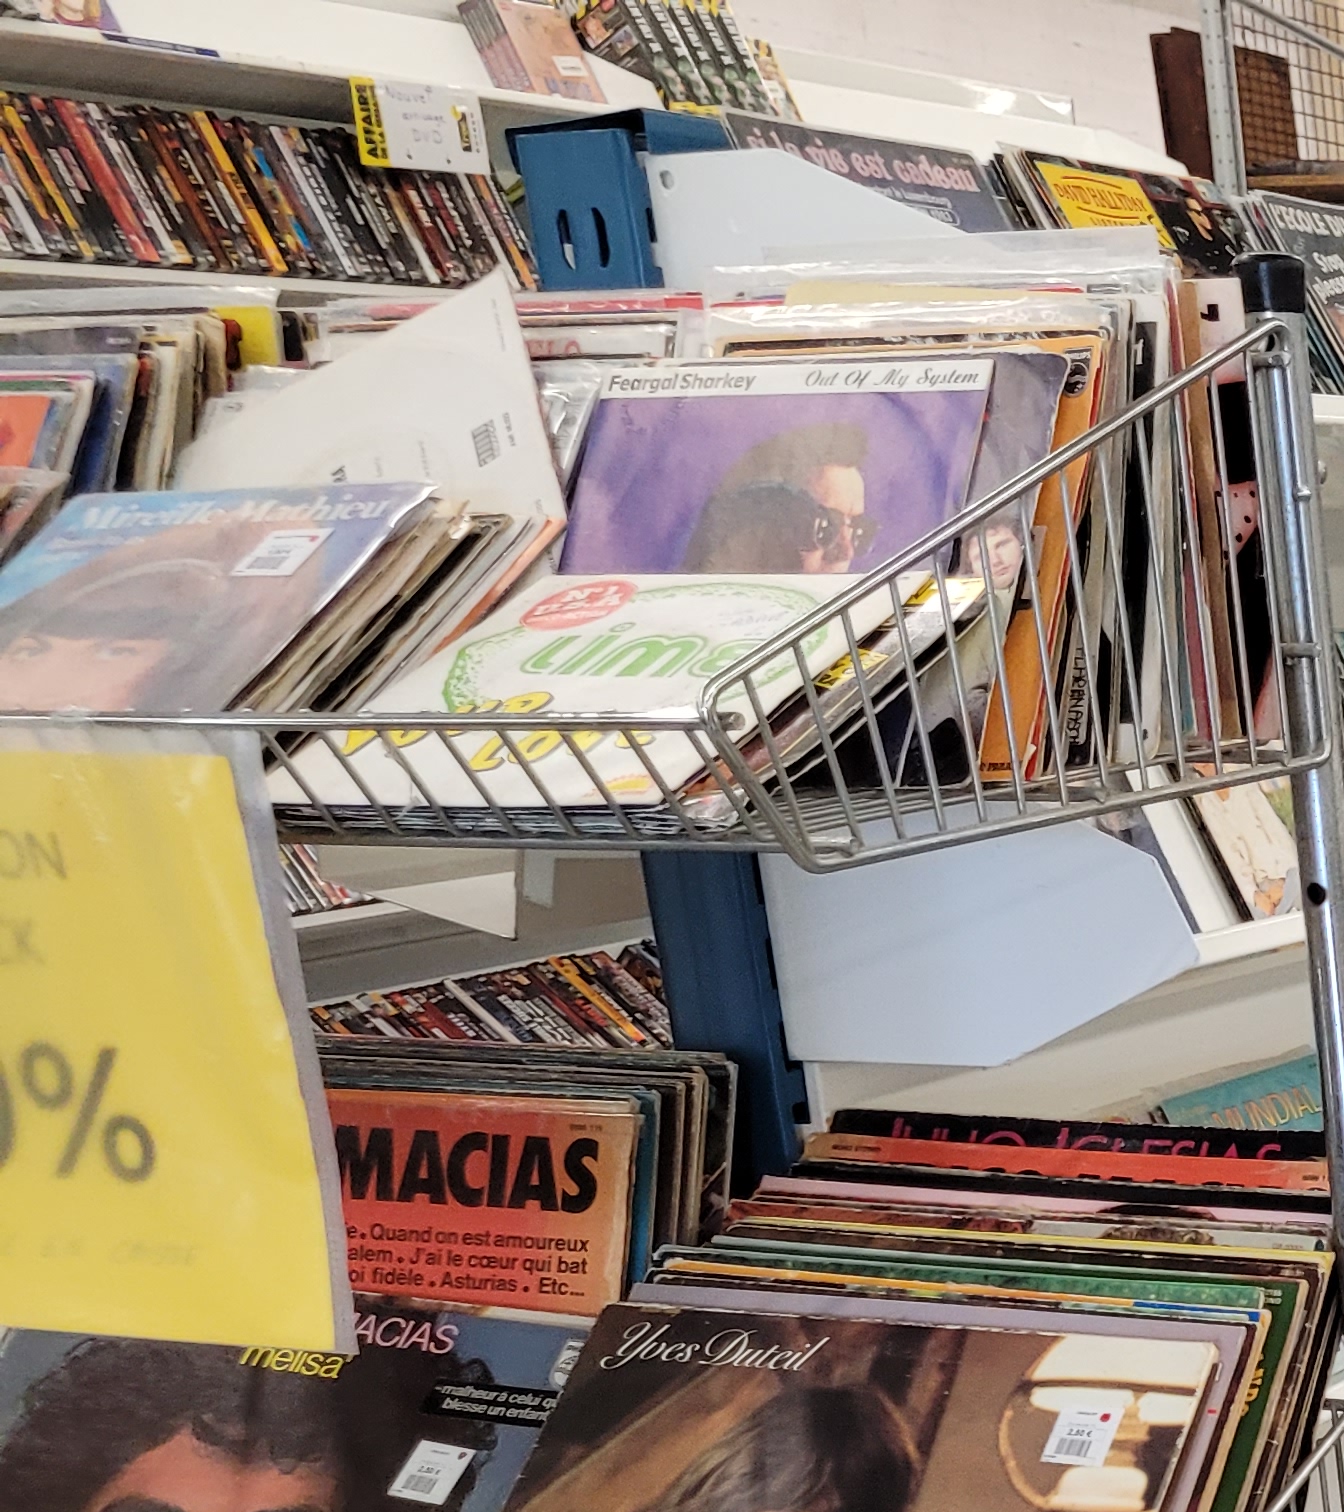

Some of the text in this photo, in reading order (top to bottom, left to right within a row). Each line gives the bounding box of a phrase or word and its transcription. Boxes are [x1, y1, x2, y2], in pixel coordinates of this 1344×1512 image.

[851, 149, 893, 182] est
[895, 154, 982, 194] cadeau
[608, 373, 678, 394] Feargal
[680, 371, 757, 391] Sharkey
[804, 369, 838, 388] Out
[879, 367, 910, 387] My
[915, 366, 980, 387] System
[80, 496, 390, 531] Mireille Mathieu
[333, 1125, 600, 1214] MACIAS
[370, 1224, 590, 1252] Quand on est amoureux
[408, 1248, 443, 1269] J'ai
[447, 1251, 464, 1269] le
[467, 1256, 518, 1272] cœur
[521, 1256, 554, 1277] qui
[557, 1257, 589, 1274] bat
[371, 1265, 425, 1286] fidèle
[438, 1272, 518, 1292] Asturias
[600, 1320, 832, 1375] Yves Duteil
[441, 1397, 485, 1414] blesse
[487, 1402, 505, 1417] un
